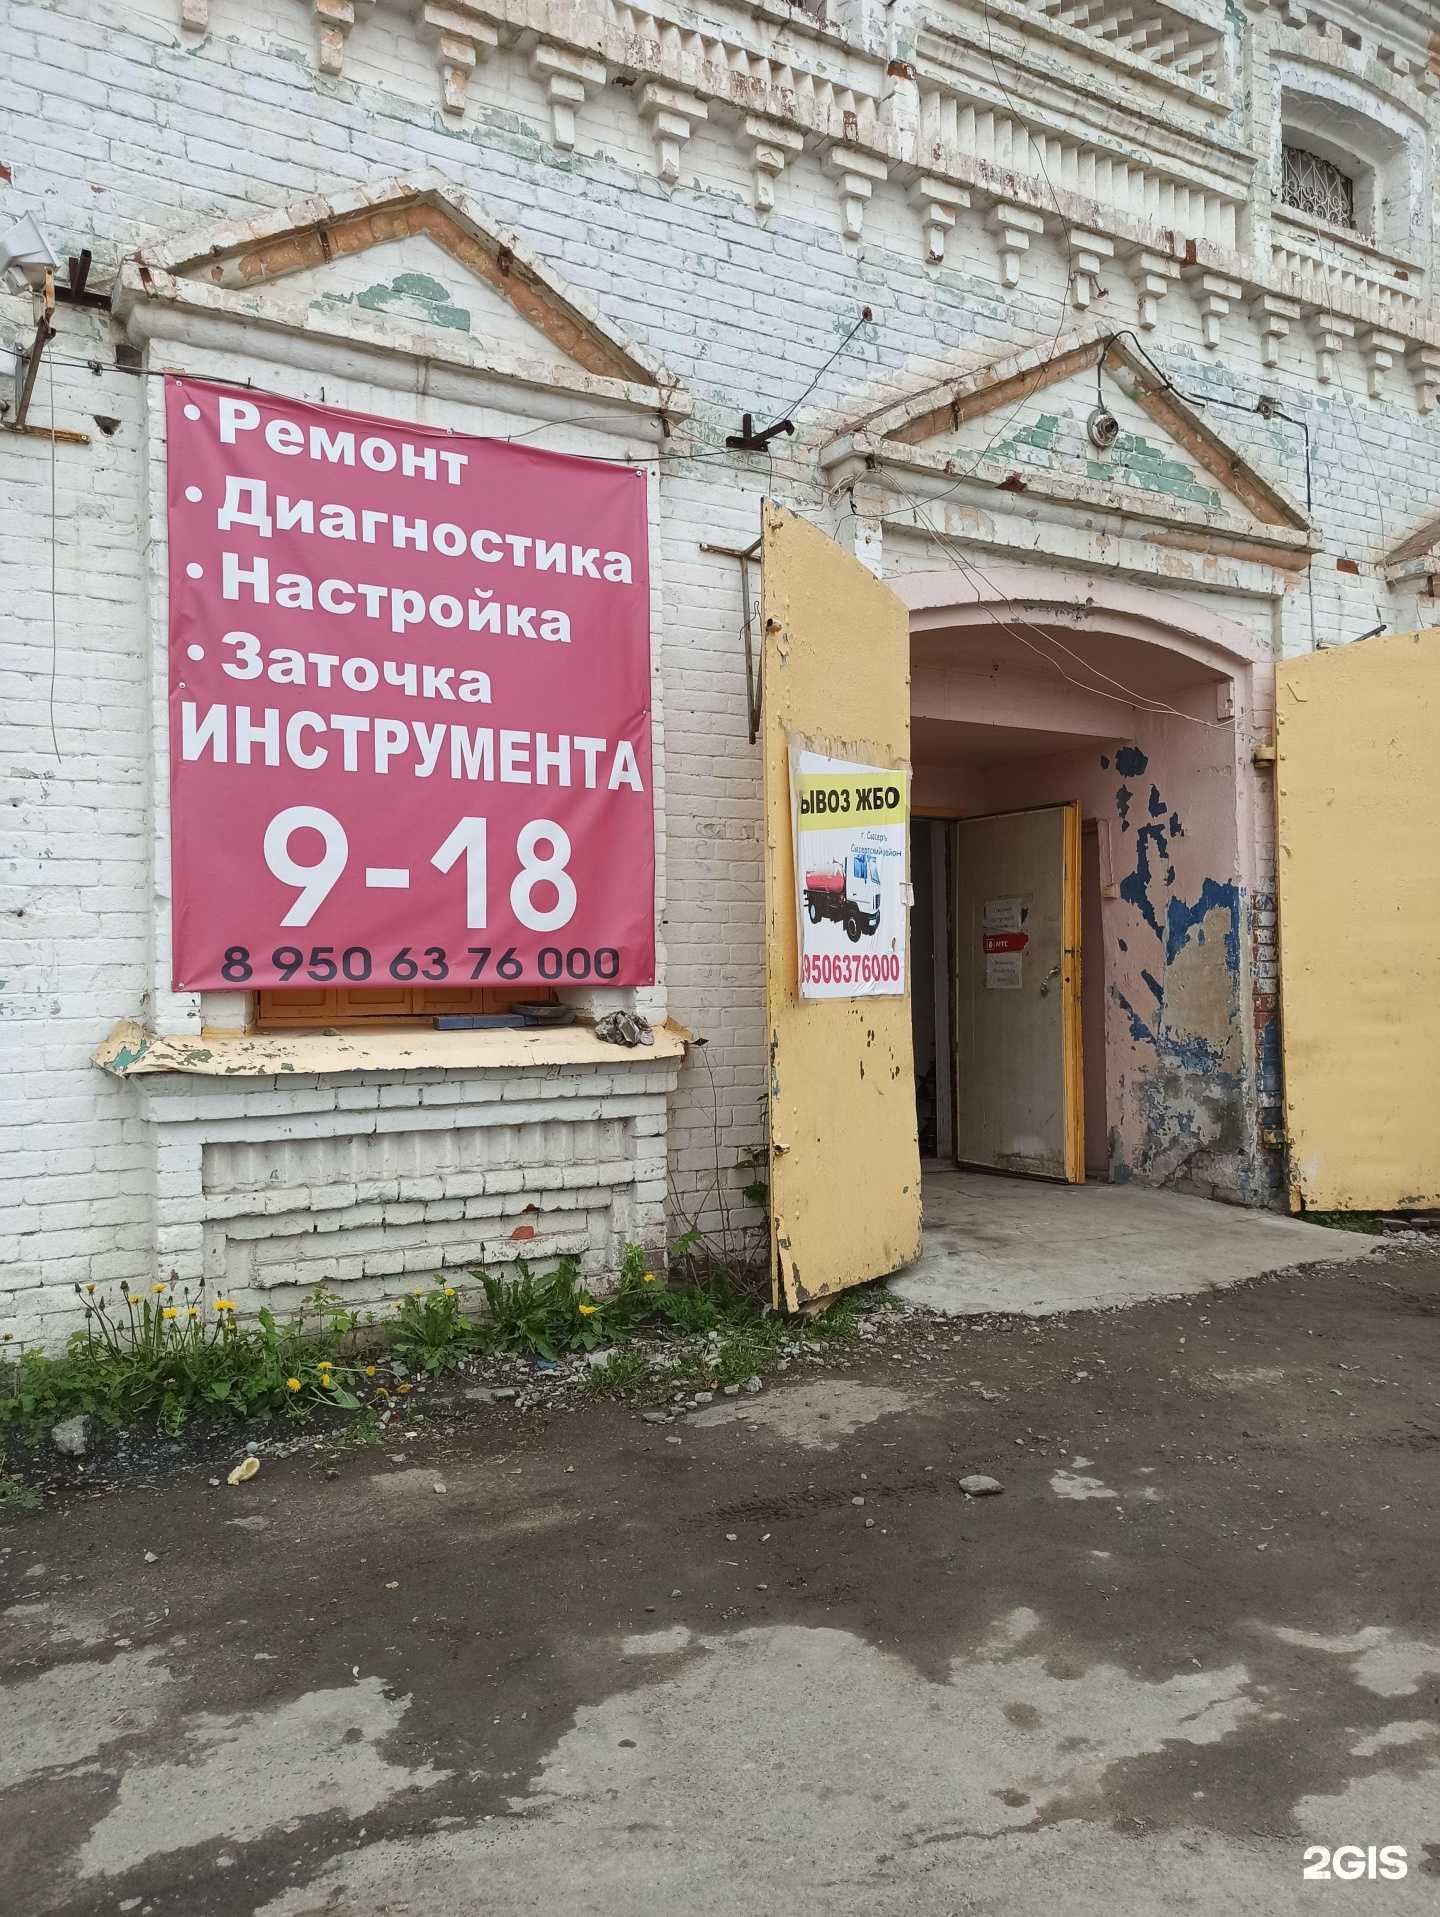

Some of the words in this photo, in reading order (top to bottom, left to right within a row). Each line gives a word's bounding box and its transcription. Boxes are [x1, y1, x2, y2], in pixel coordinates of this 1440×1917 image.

[218, 396, 469, 486] Ремонт
[217, 475, 634, 585] Диагностика
[221, 551, 572, 643] Настройка
[221, 631, 492, 704] Заточка
[181, 701, 645, 792] ИНСТРУМЕНТА
[855, 786, 900, 811] ЖБО
[220, 945, 254, 983] 8
[271, 946, 372, 982] 950
[389, 947, 449, 981] 63
[467, 947, 523, 980] 76
[537, 947, 620, 981] 000
